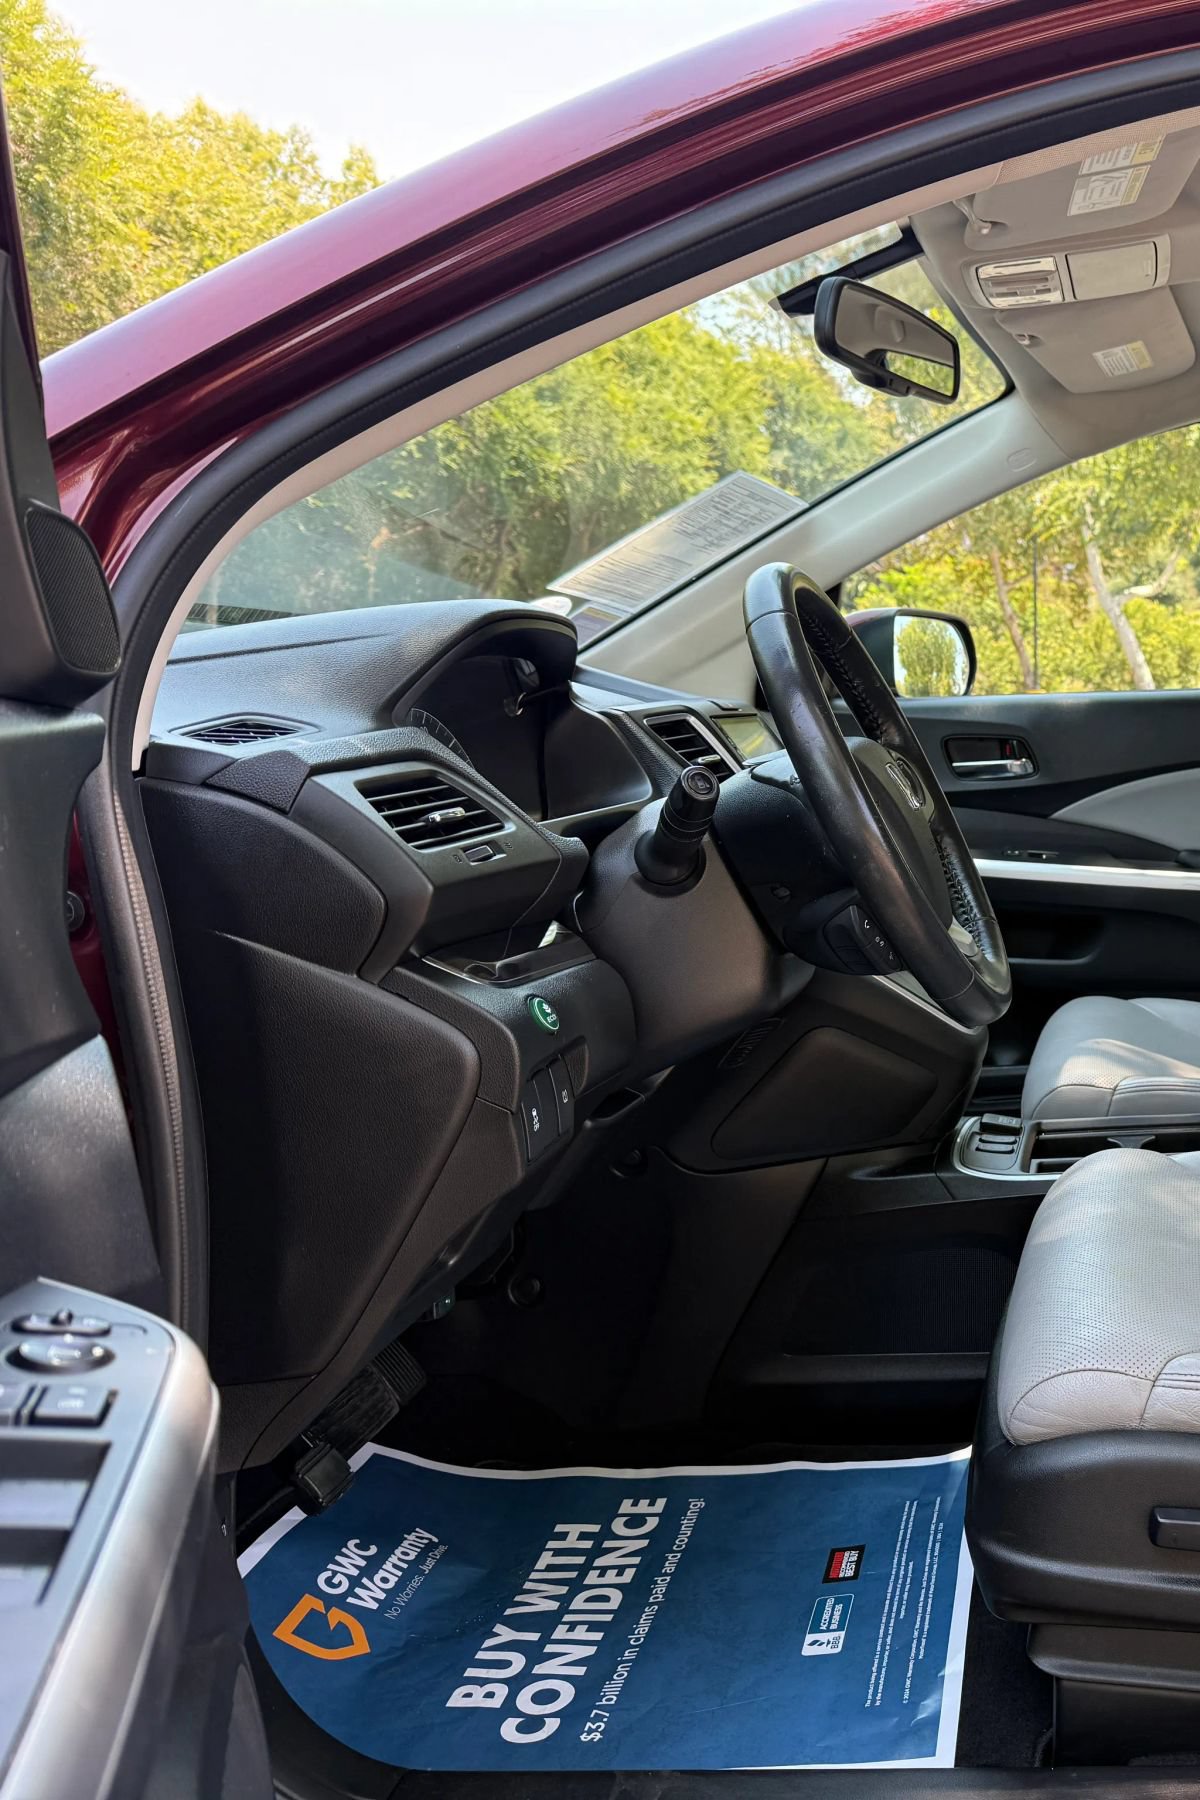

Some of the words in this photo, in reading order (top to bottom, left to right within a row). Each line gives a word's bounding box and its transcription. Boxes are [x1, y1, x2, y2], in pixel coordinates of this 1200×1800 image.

[547, 1014, 557, 1023] ECO
[672, 1498, 706, 1551] counting!
[316, 1538, 378, 1596] GWC
[346, 1527, 439, 1611] Warranty
[662, 1552, 682, 1574] and
[845, 1562, 856, 1576] BEST
[848, 1551, 859, 1561] BUY
[383, 1606, 401, 1620] No
[393, 1574, 425, 1606] Worries.
[418, 1557, 438, 1574] Just
[648, 1576, 672, 1603] paid
[445, 1623, 544, 1709] BUY
[503, 1522, 602, 1616] WITH
[500, 1497, 667, 1744] CONFIDENCE
[627, 1604, 659, 1646] claims
[819, 1597, 835, 1630] ACCREDITED
[830, 1604, 843, 1629] BUSINESS
[617, 1647, 640, 1661] in
[831, 1636, 841, 1648] BBB
[595, 1662, 633, 1705] billion
[579, 1709, 610, 1742] $3.7
